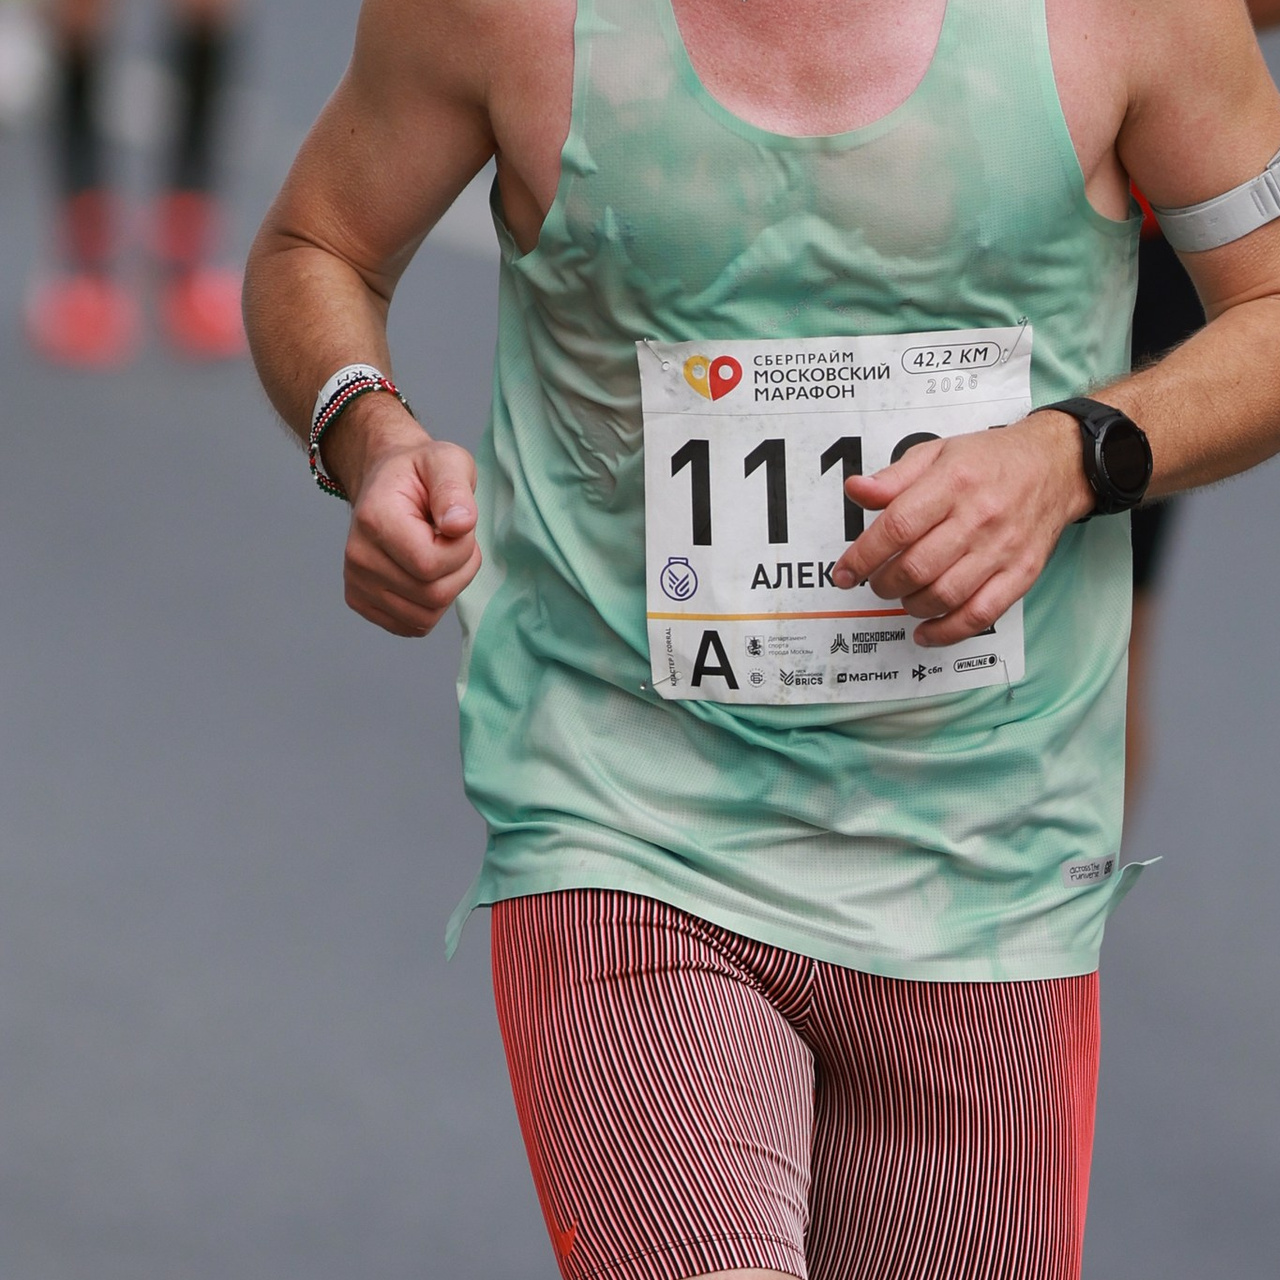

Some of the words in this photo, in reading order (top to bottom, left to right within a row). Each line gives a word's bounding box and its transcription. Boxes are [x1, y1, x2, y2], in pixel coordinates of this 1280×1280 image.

[753, 350, 854, 366] СБЕРПРАЙМ
[913, 349, 951, 368] 42,2
[754, 362, 890, 384] МОСКОВСКИЙ
[926, 374, 979, 394] 2026
[754, 384, 855, 402] МАРАФОН
[671, 424, 1010, 547] 111
[852, 628, 906, 643] МОСКОВСКИЙ
[852, 642, 878, 654] СПОРТ
[956, 657, 988, 670] WINLINE
[795, 677, 823, 686] BRICS
